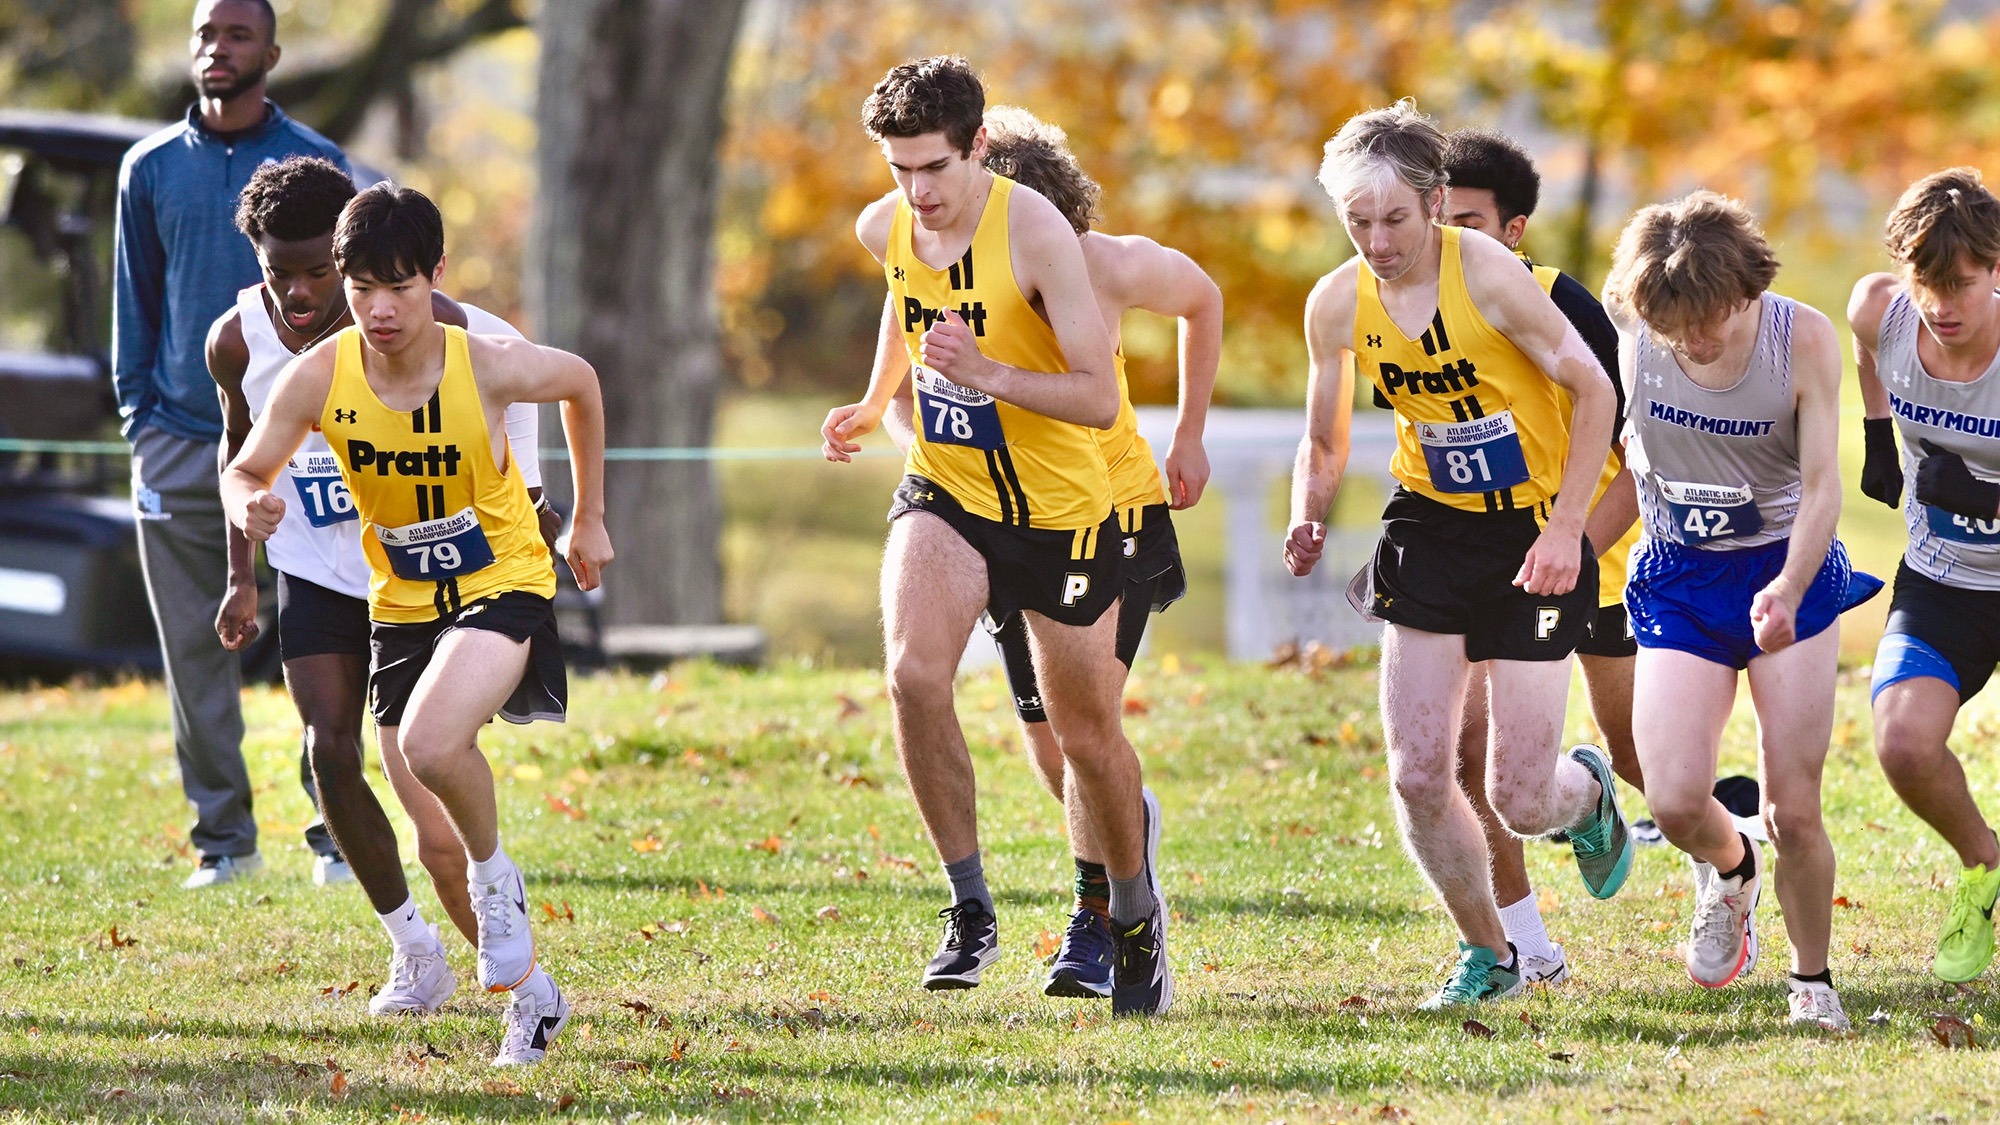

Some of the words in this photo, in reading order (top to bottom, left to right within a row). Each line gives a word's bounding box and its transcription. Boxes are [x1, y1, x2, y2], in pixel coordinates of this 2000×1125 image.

[904, 296, 987, 337] Prtt
[1379, 358, 1480, 395] Pratt
[929, 399, 973, 440] 78
[1446, 423, 1482, 436] ATLANTIC
[1483, 417, 1503, 430] EAST
[1648, 399, 1776, 437] MARYMOUNT
[1887, 389, 2000, 438] MARYMOU
[1446, 424, 1509, 444] CHAMPIONSHIPS
[308, 456, 338, 466] ATLANT
[347, 439, 461, 476] Pratt
[1446, 447, 1492, 484] 81
[305, 480, 354, 517] 16
[1683, 495, 1747, 505] CHAMPIONSHIPS
[1685, 488, 1721, 498] ATLANTIC
[1722, 491, 1742, 499] EAST
[408, 523, 446, 536] ATLANTIC
[446, 514, 466, 528] EAST
[408, 519, 472, 542] CHAMPIONSHIPS
[1683, 508, 1735, 538] 42
[406, 542, 462, 574] 79
[1060, 572, 1091, 607] P
[1535, 606, 1561, 640] P
